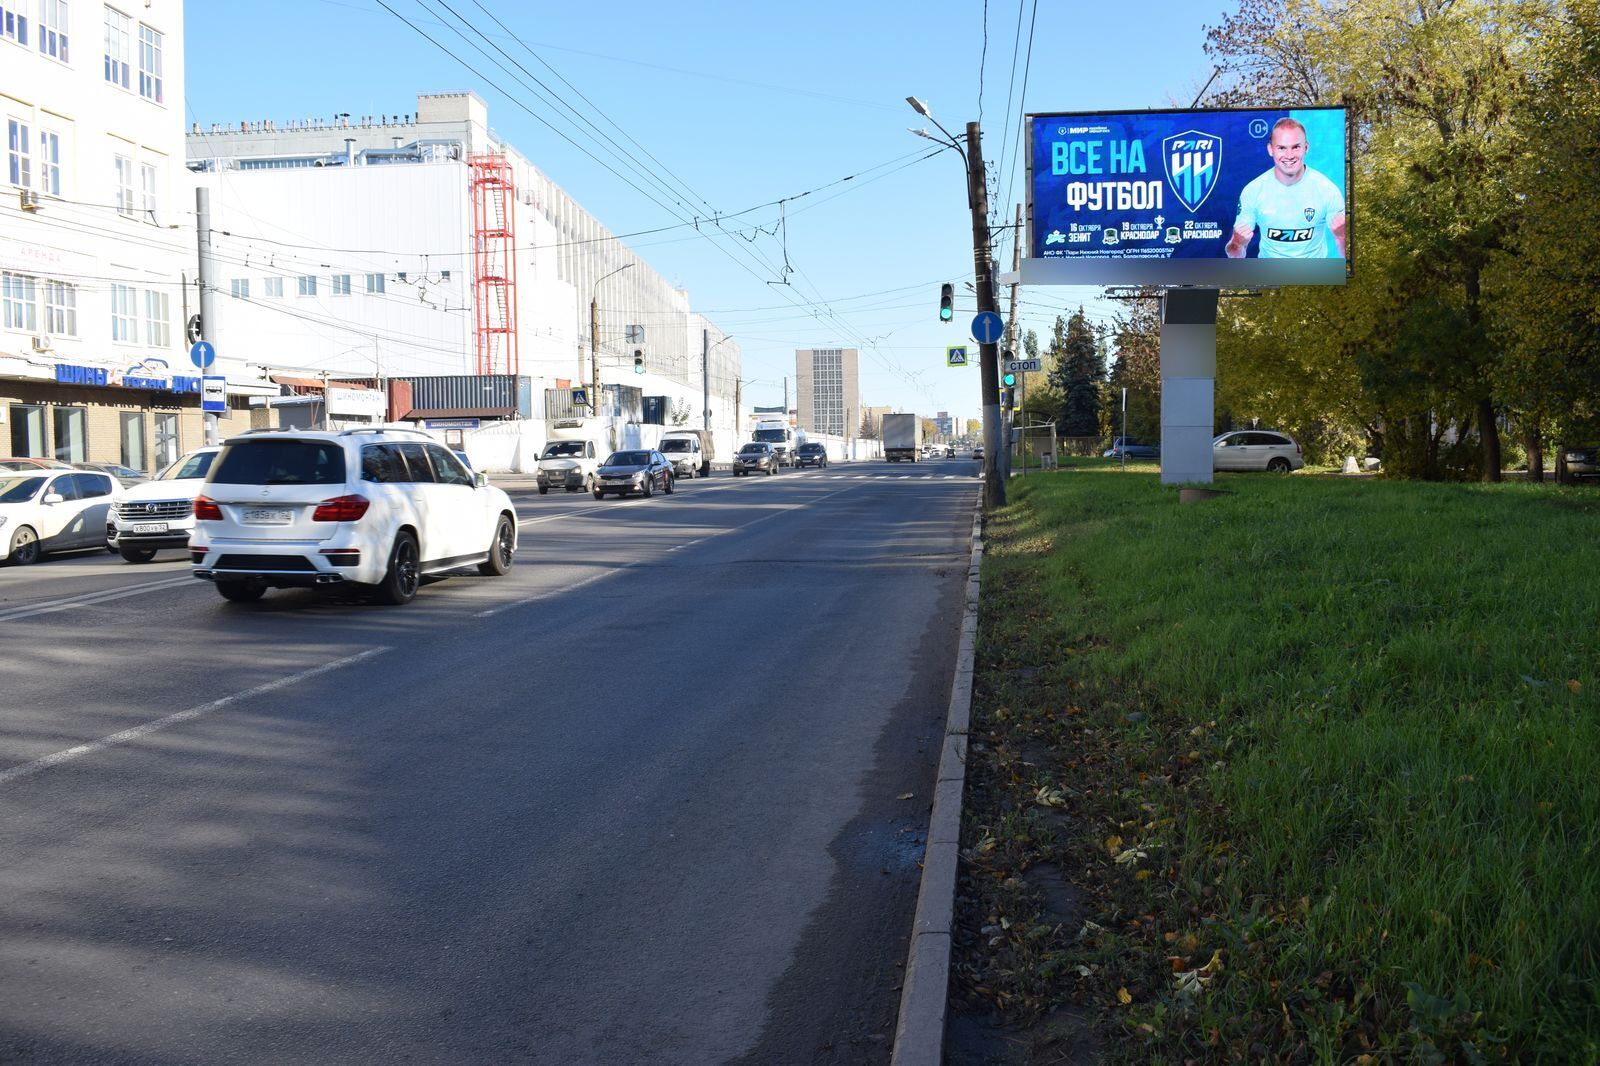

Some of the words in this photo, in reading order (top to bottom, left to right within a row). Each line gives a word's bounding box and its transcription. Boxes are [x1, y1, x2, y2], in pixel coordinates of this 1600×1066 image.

[1255, 123, 1267, 134] 0+
[1172, 140, 1213, 150] PARI
[1052, 140, 1103, 175] ВСЕ
[1110, 139, 1147, 174] НА
[1067, 180, 1163, 211] ФУТБОЛ
[1070, 223, 1077, 232] 16
[1078, 224, 1101, 232] ОКТЯБРЯ
[1122, 222, 1129, 231] 19
[1184, 221, 1193, 229] 22
[1068, 232, 1092, 242] ЗЕНИТ
[1120, 231, 1159, 240] КРАСНОДАР
[1183, 229, 1222, 239] КРАСНОДАР
[1268, 228, 1313, 241] PARI
[1010, 361, 1036, 370] СТОП
[56, 364, 107, 386] ШИНЫ
[172, 375, 201, 394] ДИС
